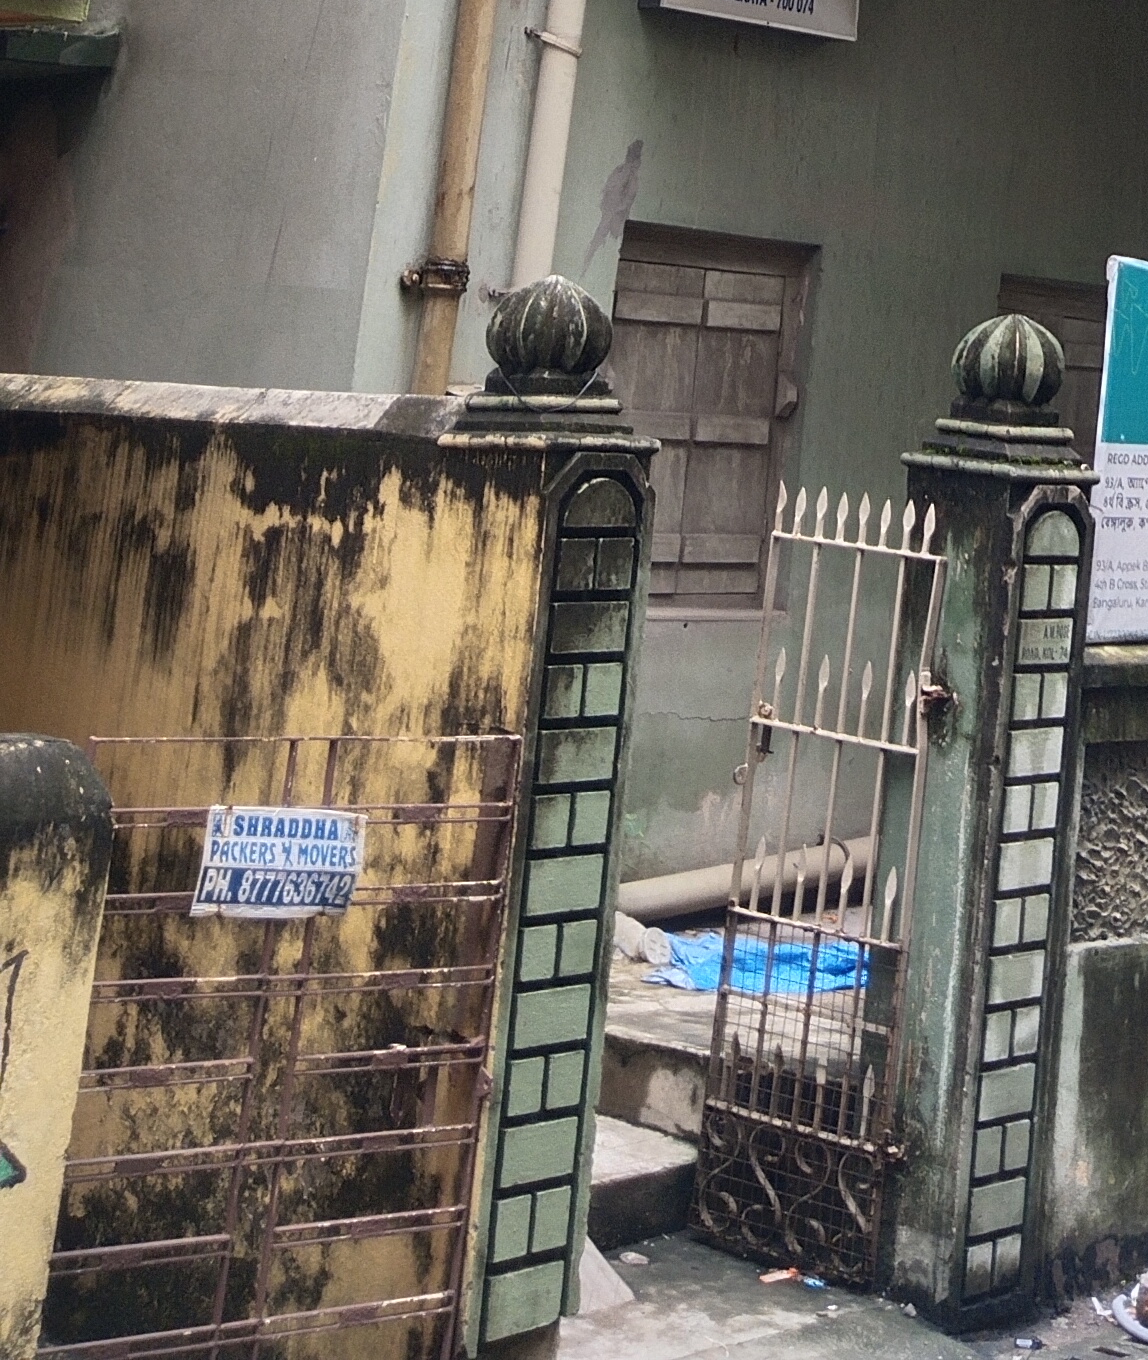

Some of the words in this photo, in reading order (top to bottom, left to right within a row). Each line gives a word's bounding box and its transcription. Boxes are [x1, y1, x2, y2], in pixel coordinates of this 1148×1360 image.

[233, 815, 339, 840] SHRADDHA
[209, 840, 276, 865] PACKERS
[297, 843, 357, 868] MOVERS
[200, 868, 232, 901] PH.
[237, 870, 351, 906] 8777636742
